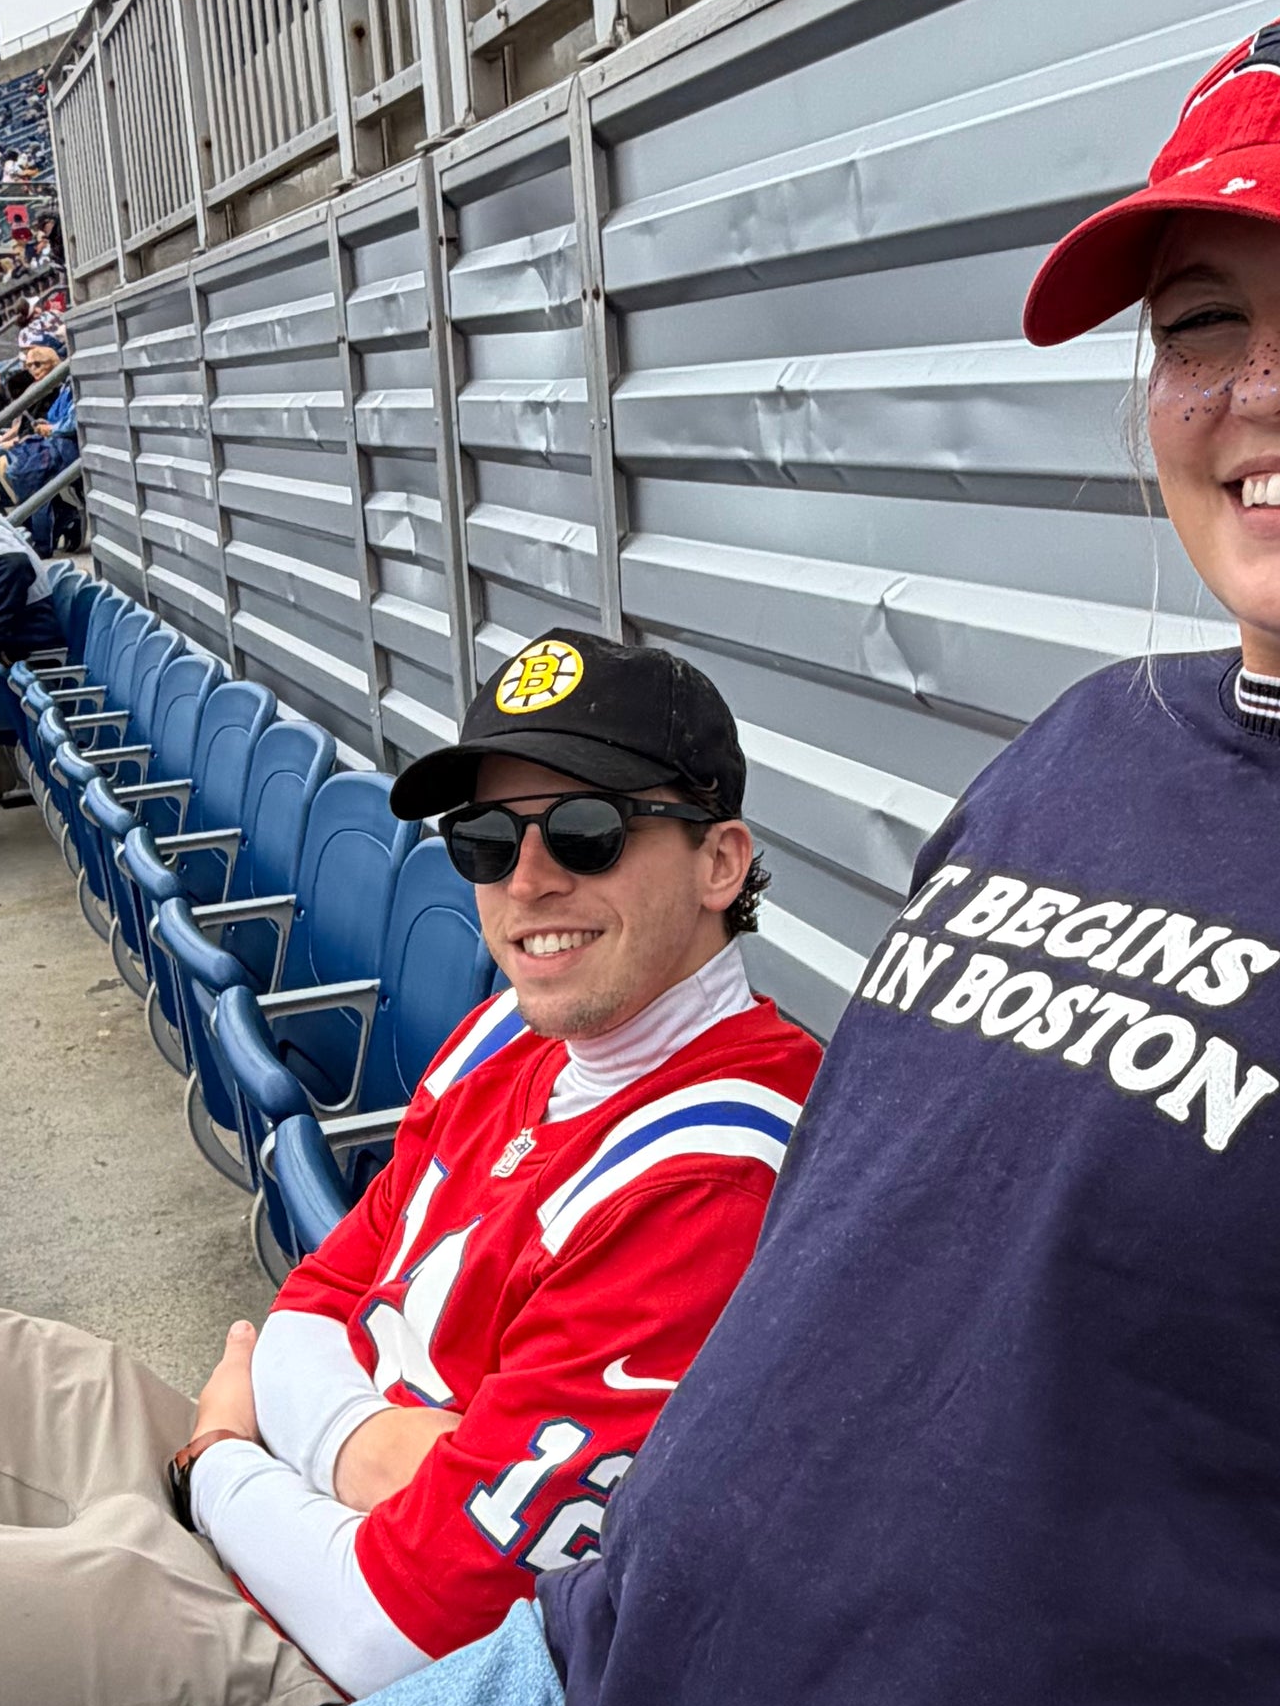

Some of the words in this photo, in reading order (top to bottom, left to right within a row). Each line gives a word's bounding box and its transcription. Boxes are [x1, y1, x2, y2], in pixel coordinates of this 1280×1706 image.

[513, 654, 560, 698] B
[897, 864, 972, 921] T
[861, 931, 955, 1012] IN
[930, 953, 1280, 1153] BOSTON
